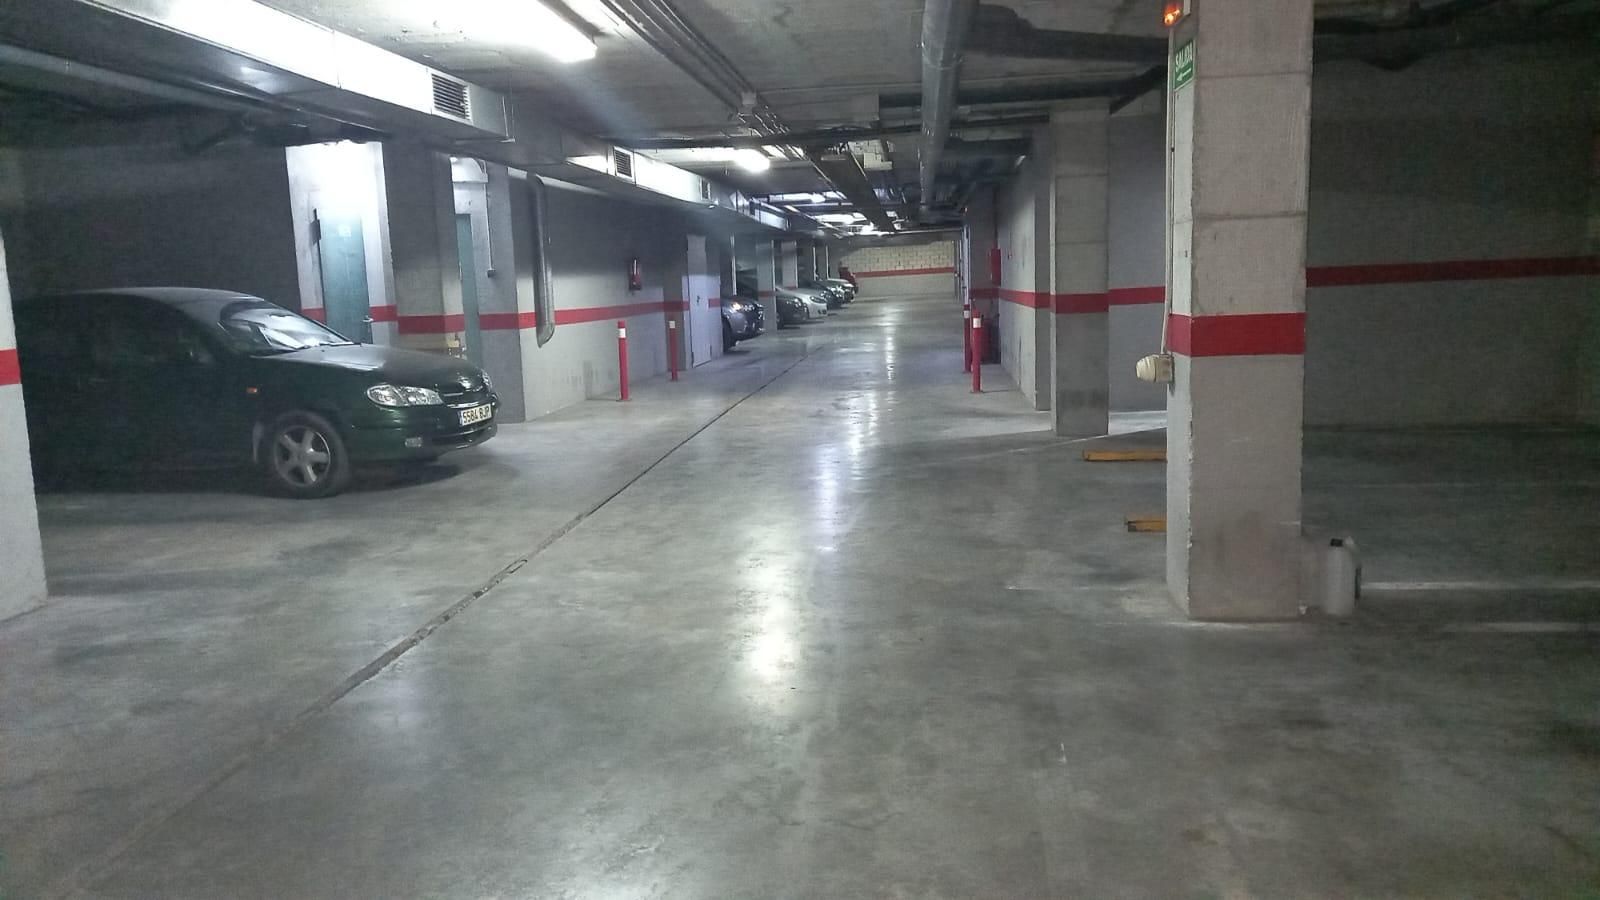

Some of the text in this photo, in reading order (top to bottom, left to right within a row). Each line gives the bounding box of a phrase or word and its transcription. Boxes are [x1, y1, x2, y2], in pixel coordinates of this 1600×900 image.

[1175, 41, 1193, 73] SALIDA
[463, 406, 489, 423] 5584 BJP
